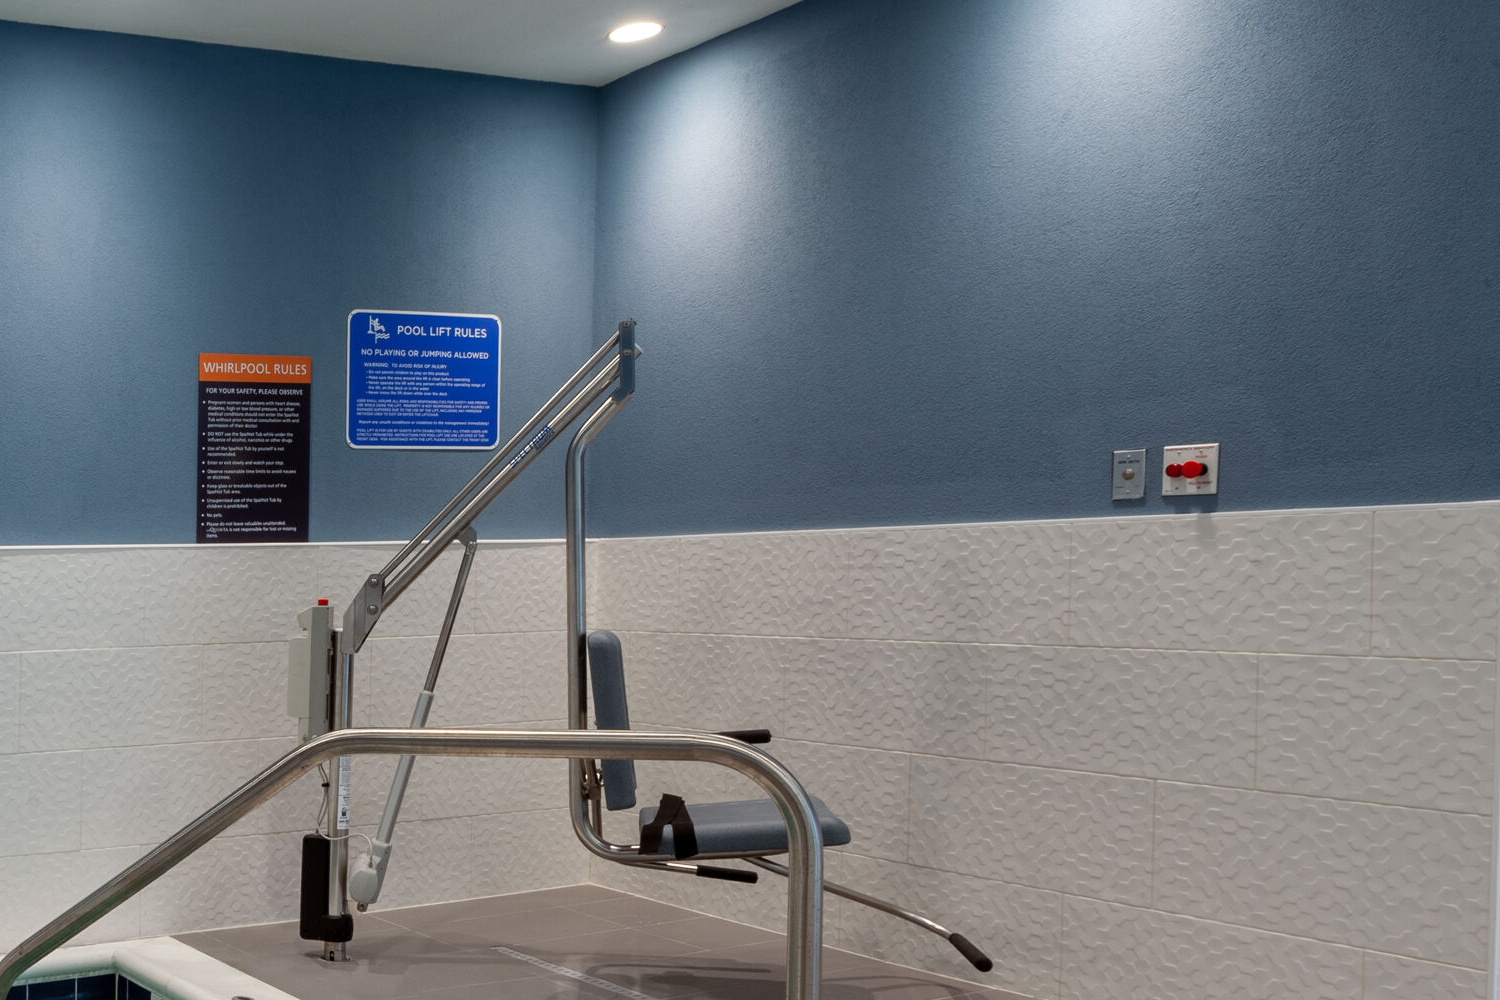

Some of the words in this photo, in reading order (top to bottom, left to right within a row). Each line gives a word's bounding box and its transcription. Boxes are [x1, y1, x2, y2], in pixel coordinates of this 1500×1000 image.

[398, 326, 426, 336] POOL
[430, 327, 451, 336] LIFT
[454, 328, 487, 338] RULES
[204, 362, 271, 374] WHIRLPOOL
[274, 364, 307, 375] RULES
